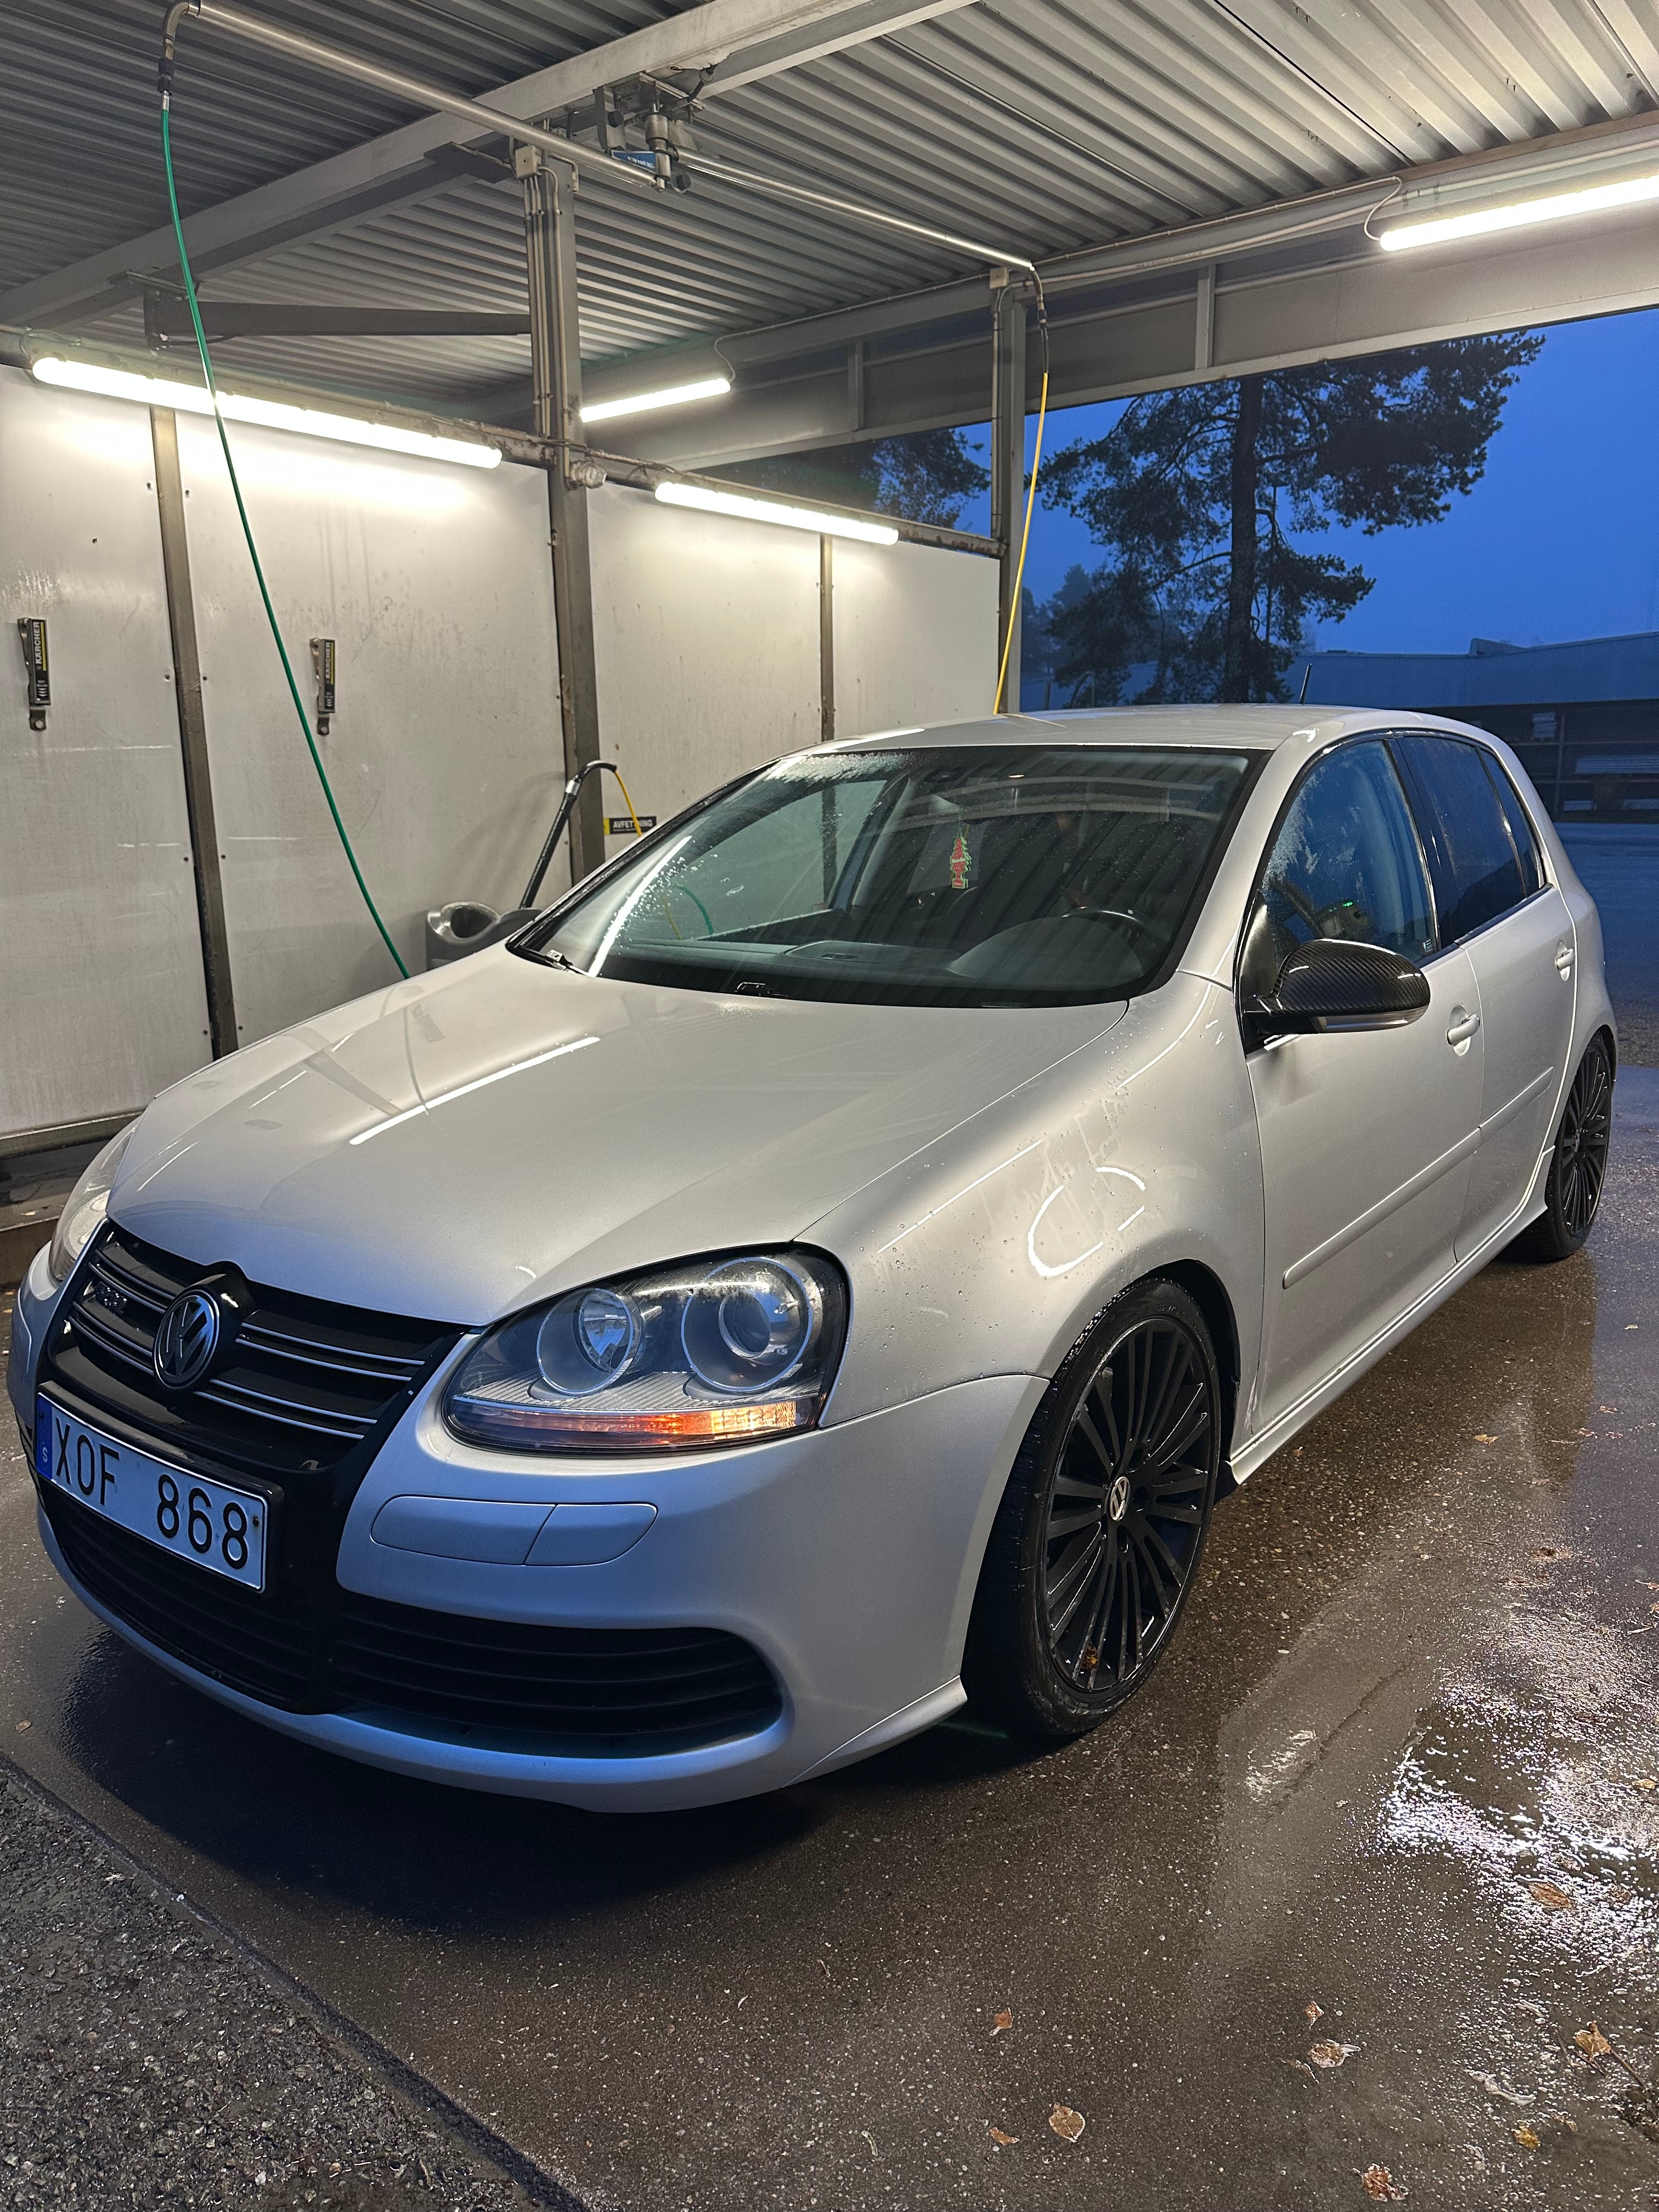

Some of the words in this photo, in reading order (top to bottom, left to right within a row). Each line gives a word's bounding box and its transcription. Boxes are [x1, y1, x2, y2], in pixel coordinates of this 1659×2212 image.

[42, 1447, 48, 1463] S
[56, 1417, 120, 1505] XOF
[157, 1474, 249, 1570] 868
